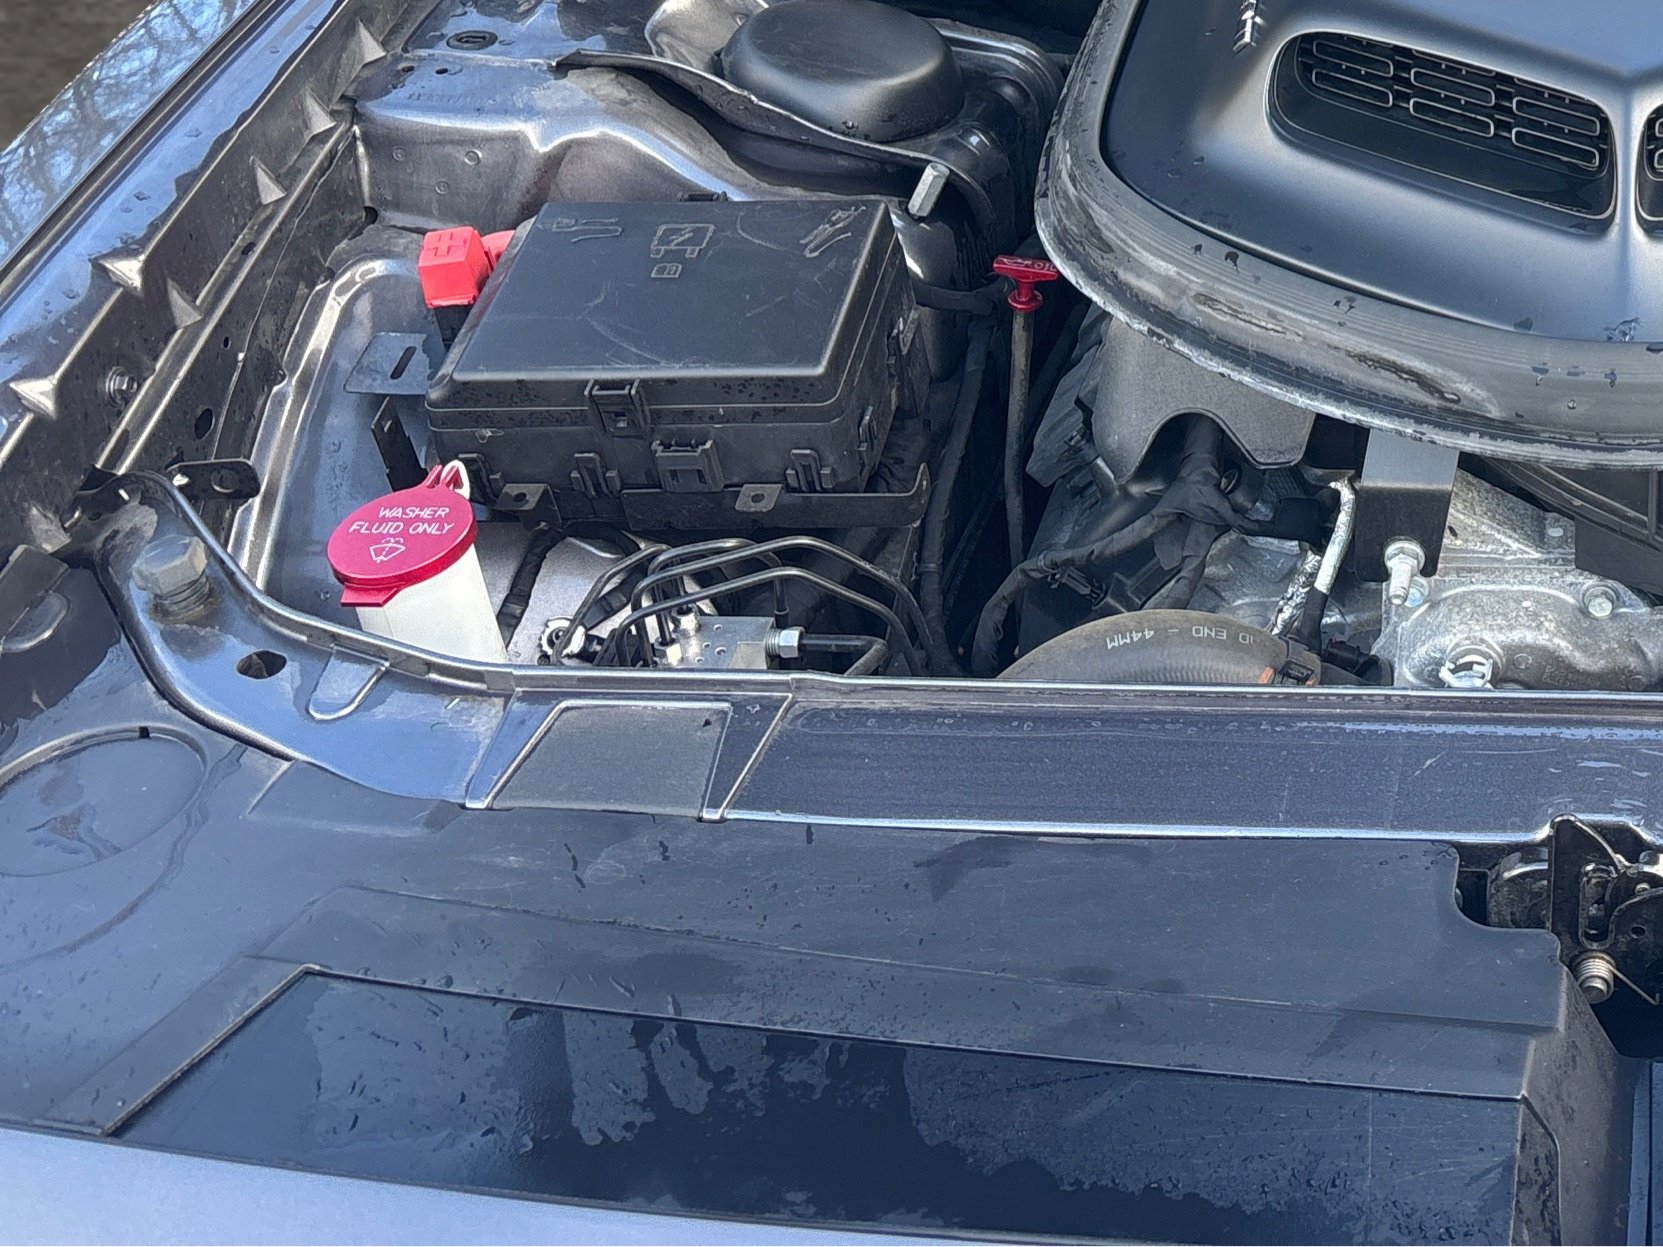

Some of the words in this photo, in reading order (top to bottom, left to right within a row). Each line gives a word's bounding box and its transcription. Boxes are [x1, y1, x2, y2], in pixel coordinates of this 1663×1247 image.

[377, 505, 450, 519] WASHER
[348, 521, 404, 534] FLUID
[408, 521, 456, 535] ONLY
[1106, 627, 1155, 650] 44MM
[1192, 625, 1227, 640] END
